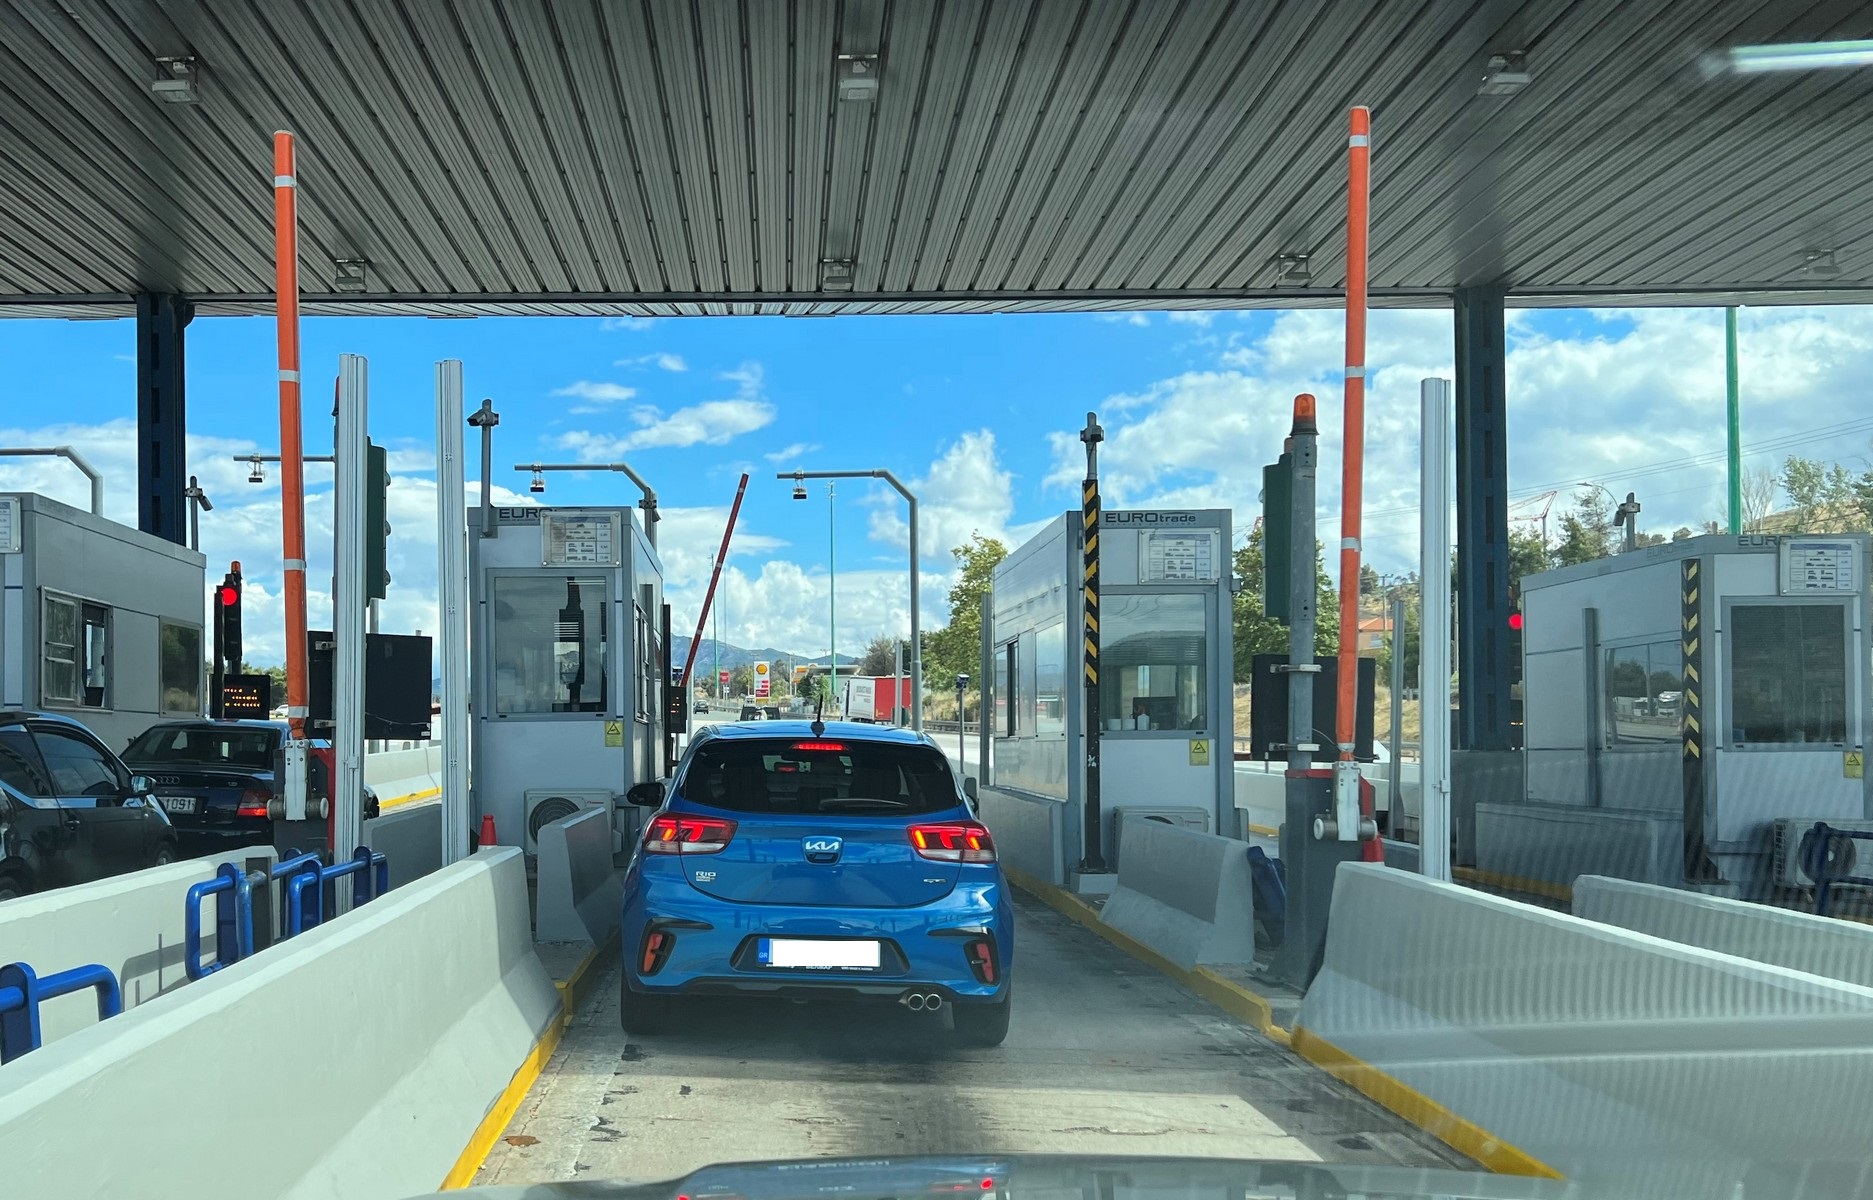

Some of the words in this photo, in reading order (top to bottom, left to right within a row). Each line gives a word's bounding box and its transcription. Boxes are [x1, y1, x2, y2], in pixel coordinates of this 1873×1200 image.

[1105, 511, 1197, 523] EUROtrade
[805, 840, 840, 851] KIA
[758, 951, 768, 959] GR
